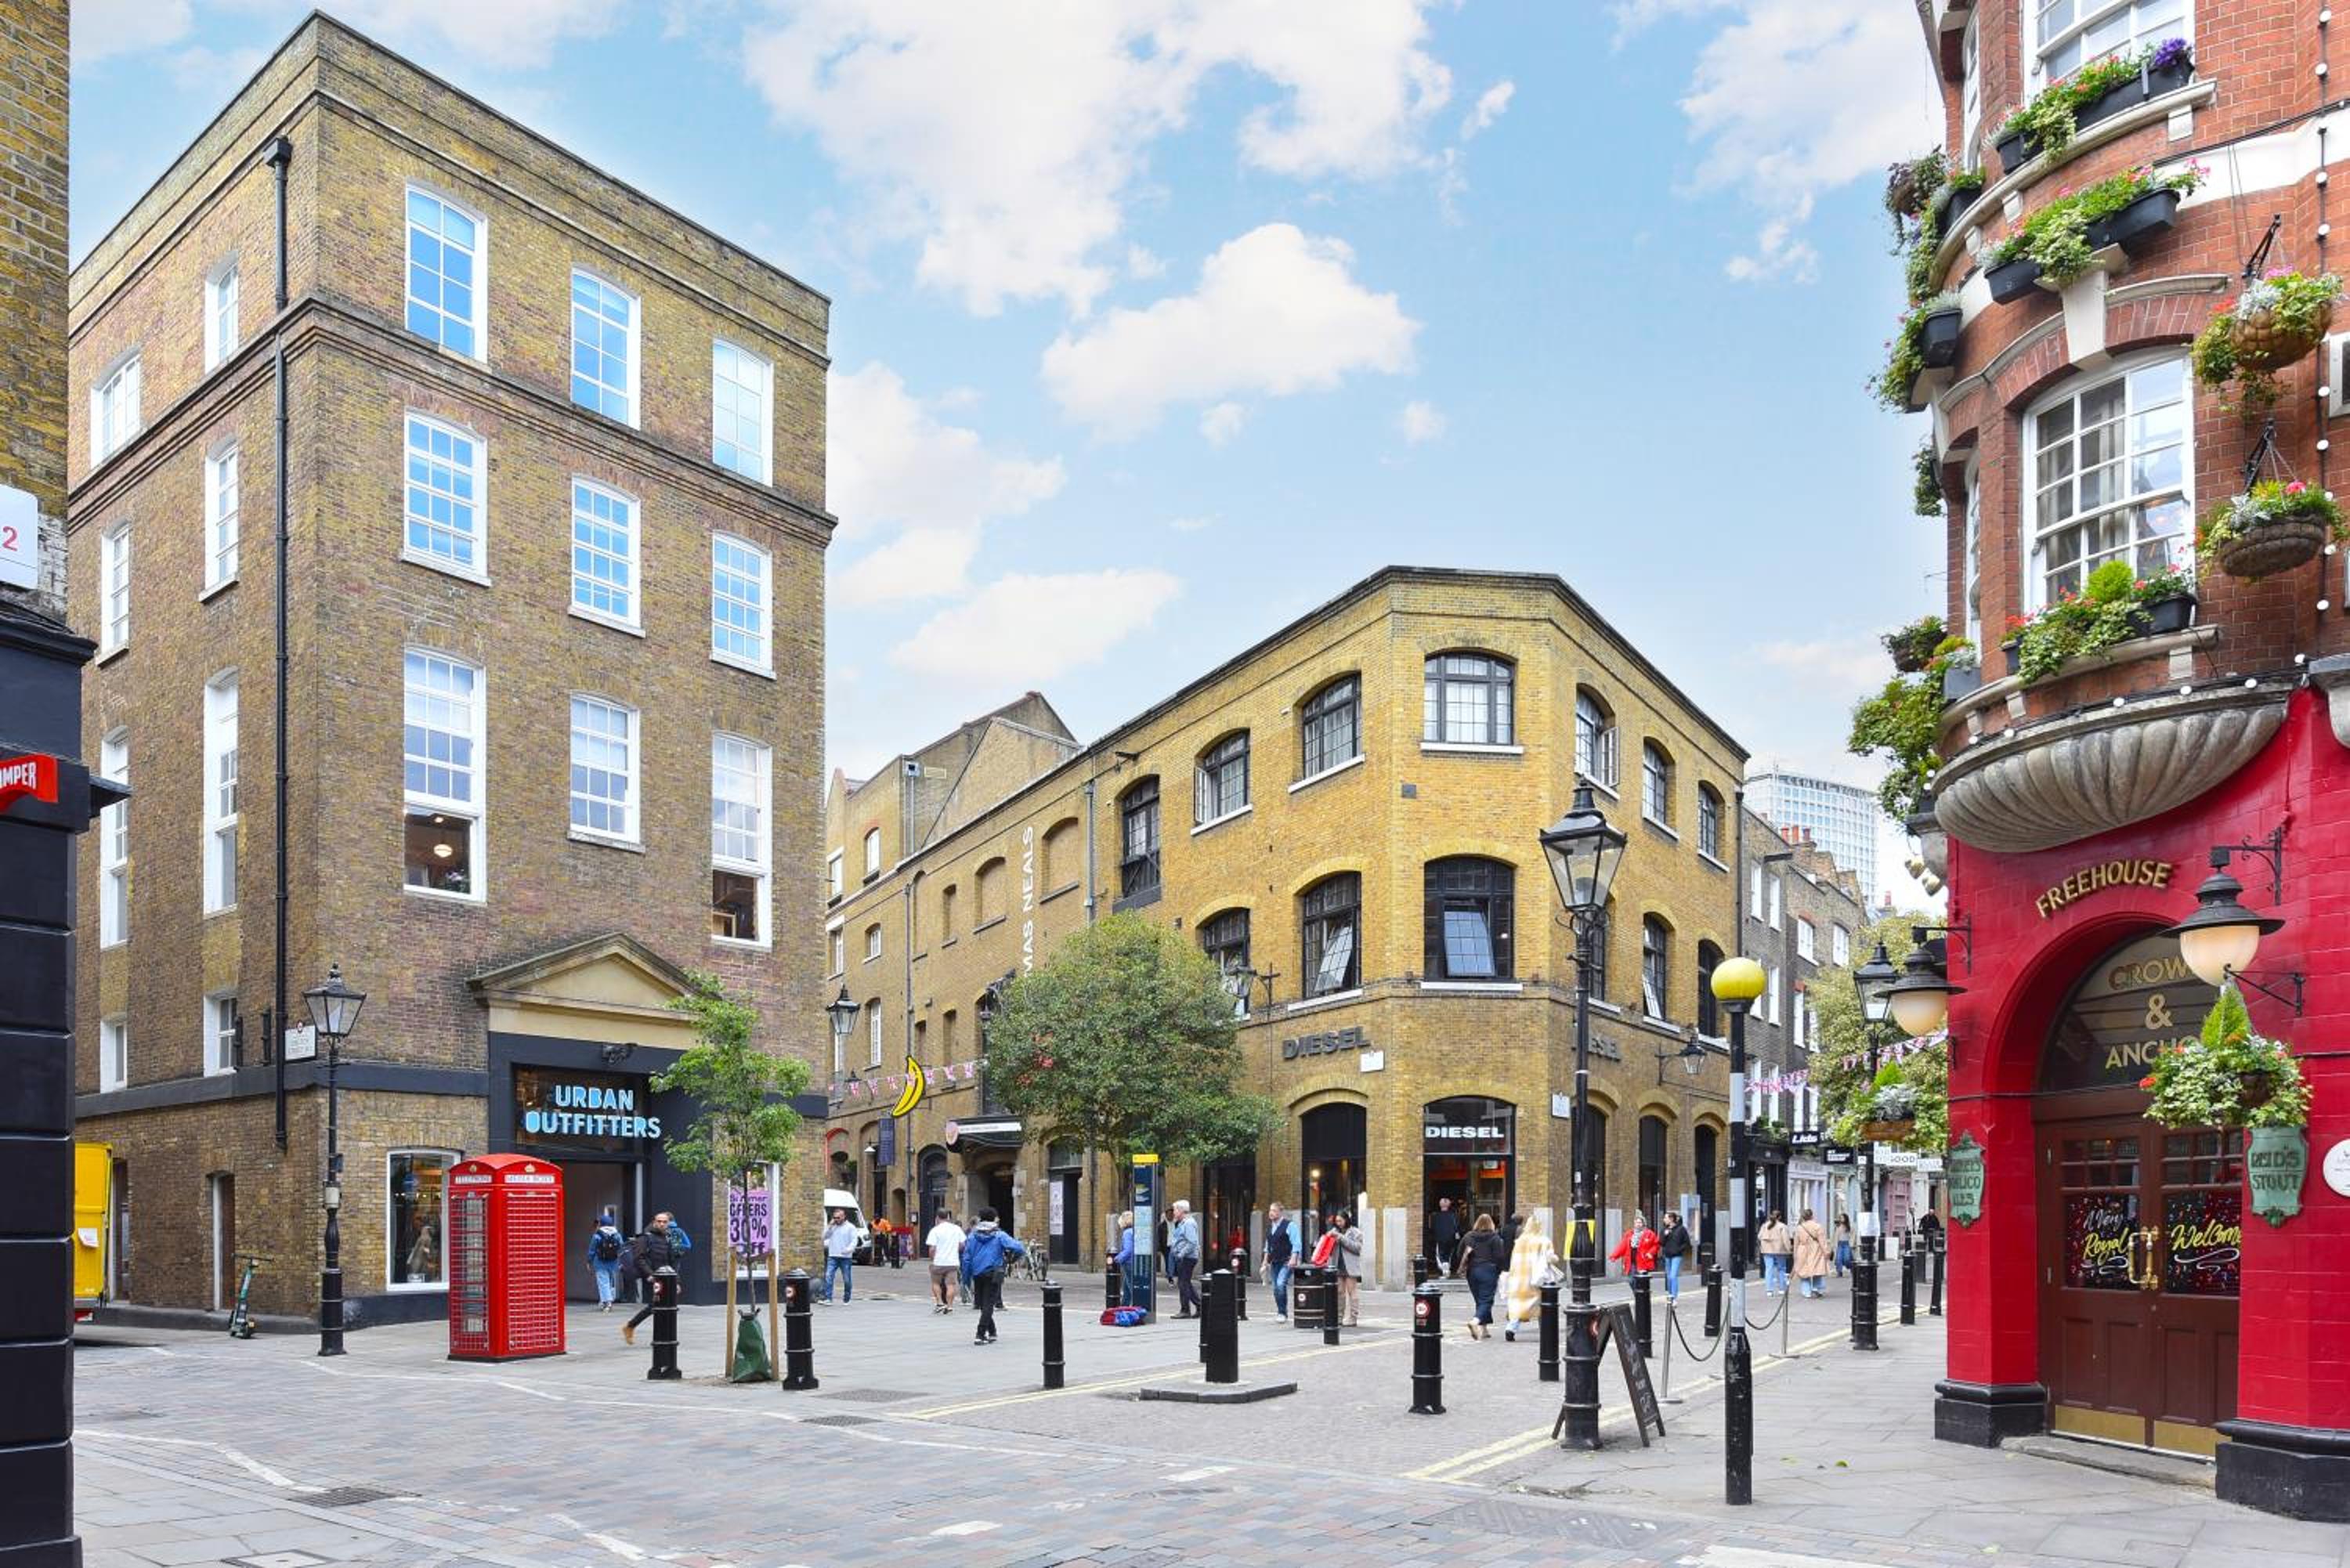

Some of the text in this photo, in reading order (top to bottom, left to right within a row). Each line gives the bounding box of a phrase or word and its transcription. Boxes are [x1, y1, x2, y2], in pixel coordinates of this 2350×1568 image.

[0, 762, 37, 789] MPER
[2035, 860, 2172, 919] FREEHOUSE
[2108, 956, 2188, 991] CROW
[2145, 994, 2173, 1030] &
[1282, 1025, 1372, 1060] DIESEL
[555, 1085, 633, 1111] URBAN
[526, 1110, 661, 1139] OUTFITTERS
[1425, 1125, 1505, 1139] DIESEL
[2252, 1174, 2299, 1190] STOUT
[2083, 1227, 2130, 1266] Royal
